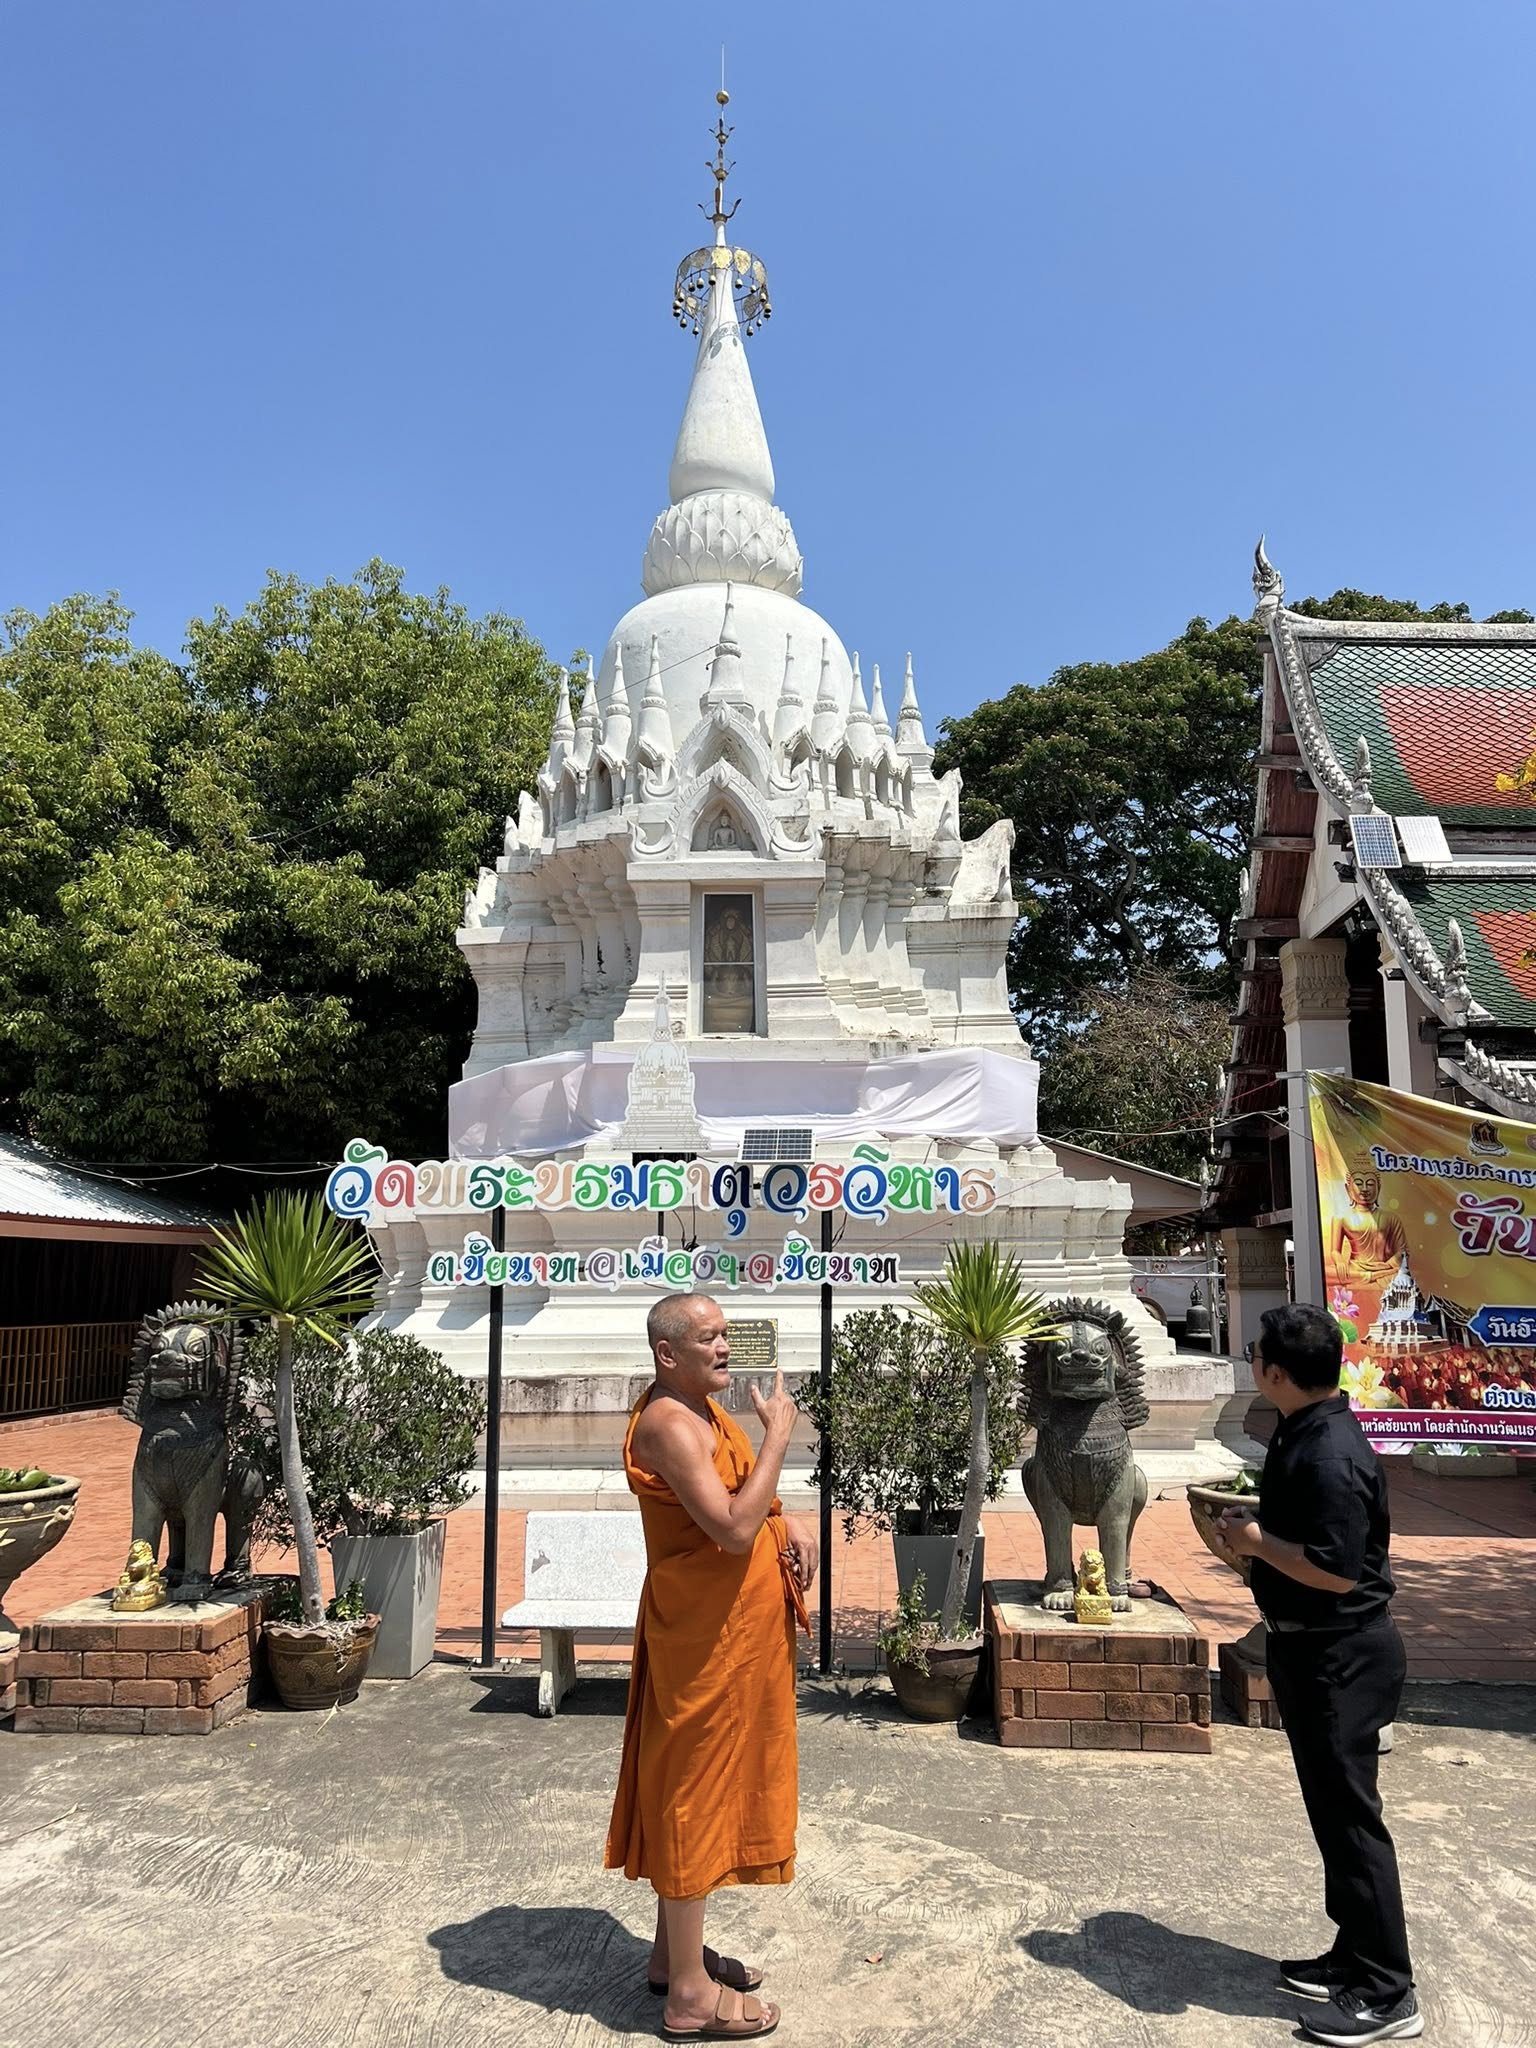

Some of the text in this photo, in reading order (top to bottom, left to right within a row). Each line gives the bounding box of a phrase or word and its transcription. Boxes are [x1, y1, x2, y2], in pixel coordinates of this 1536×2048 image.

[1371, 1147, 1536, 1185] โครงการจัดกิจกร
[1424, 1418, 1536, 1436] โดยสำนักงานวัฒนธ
